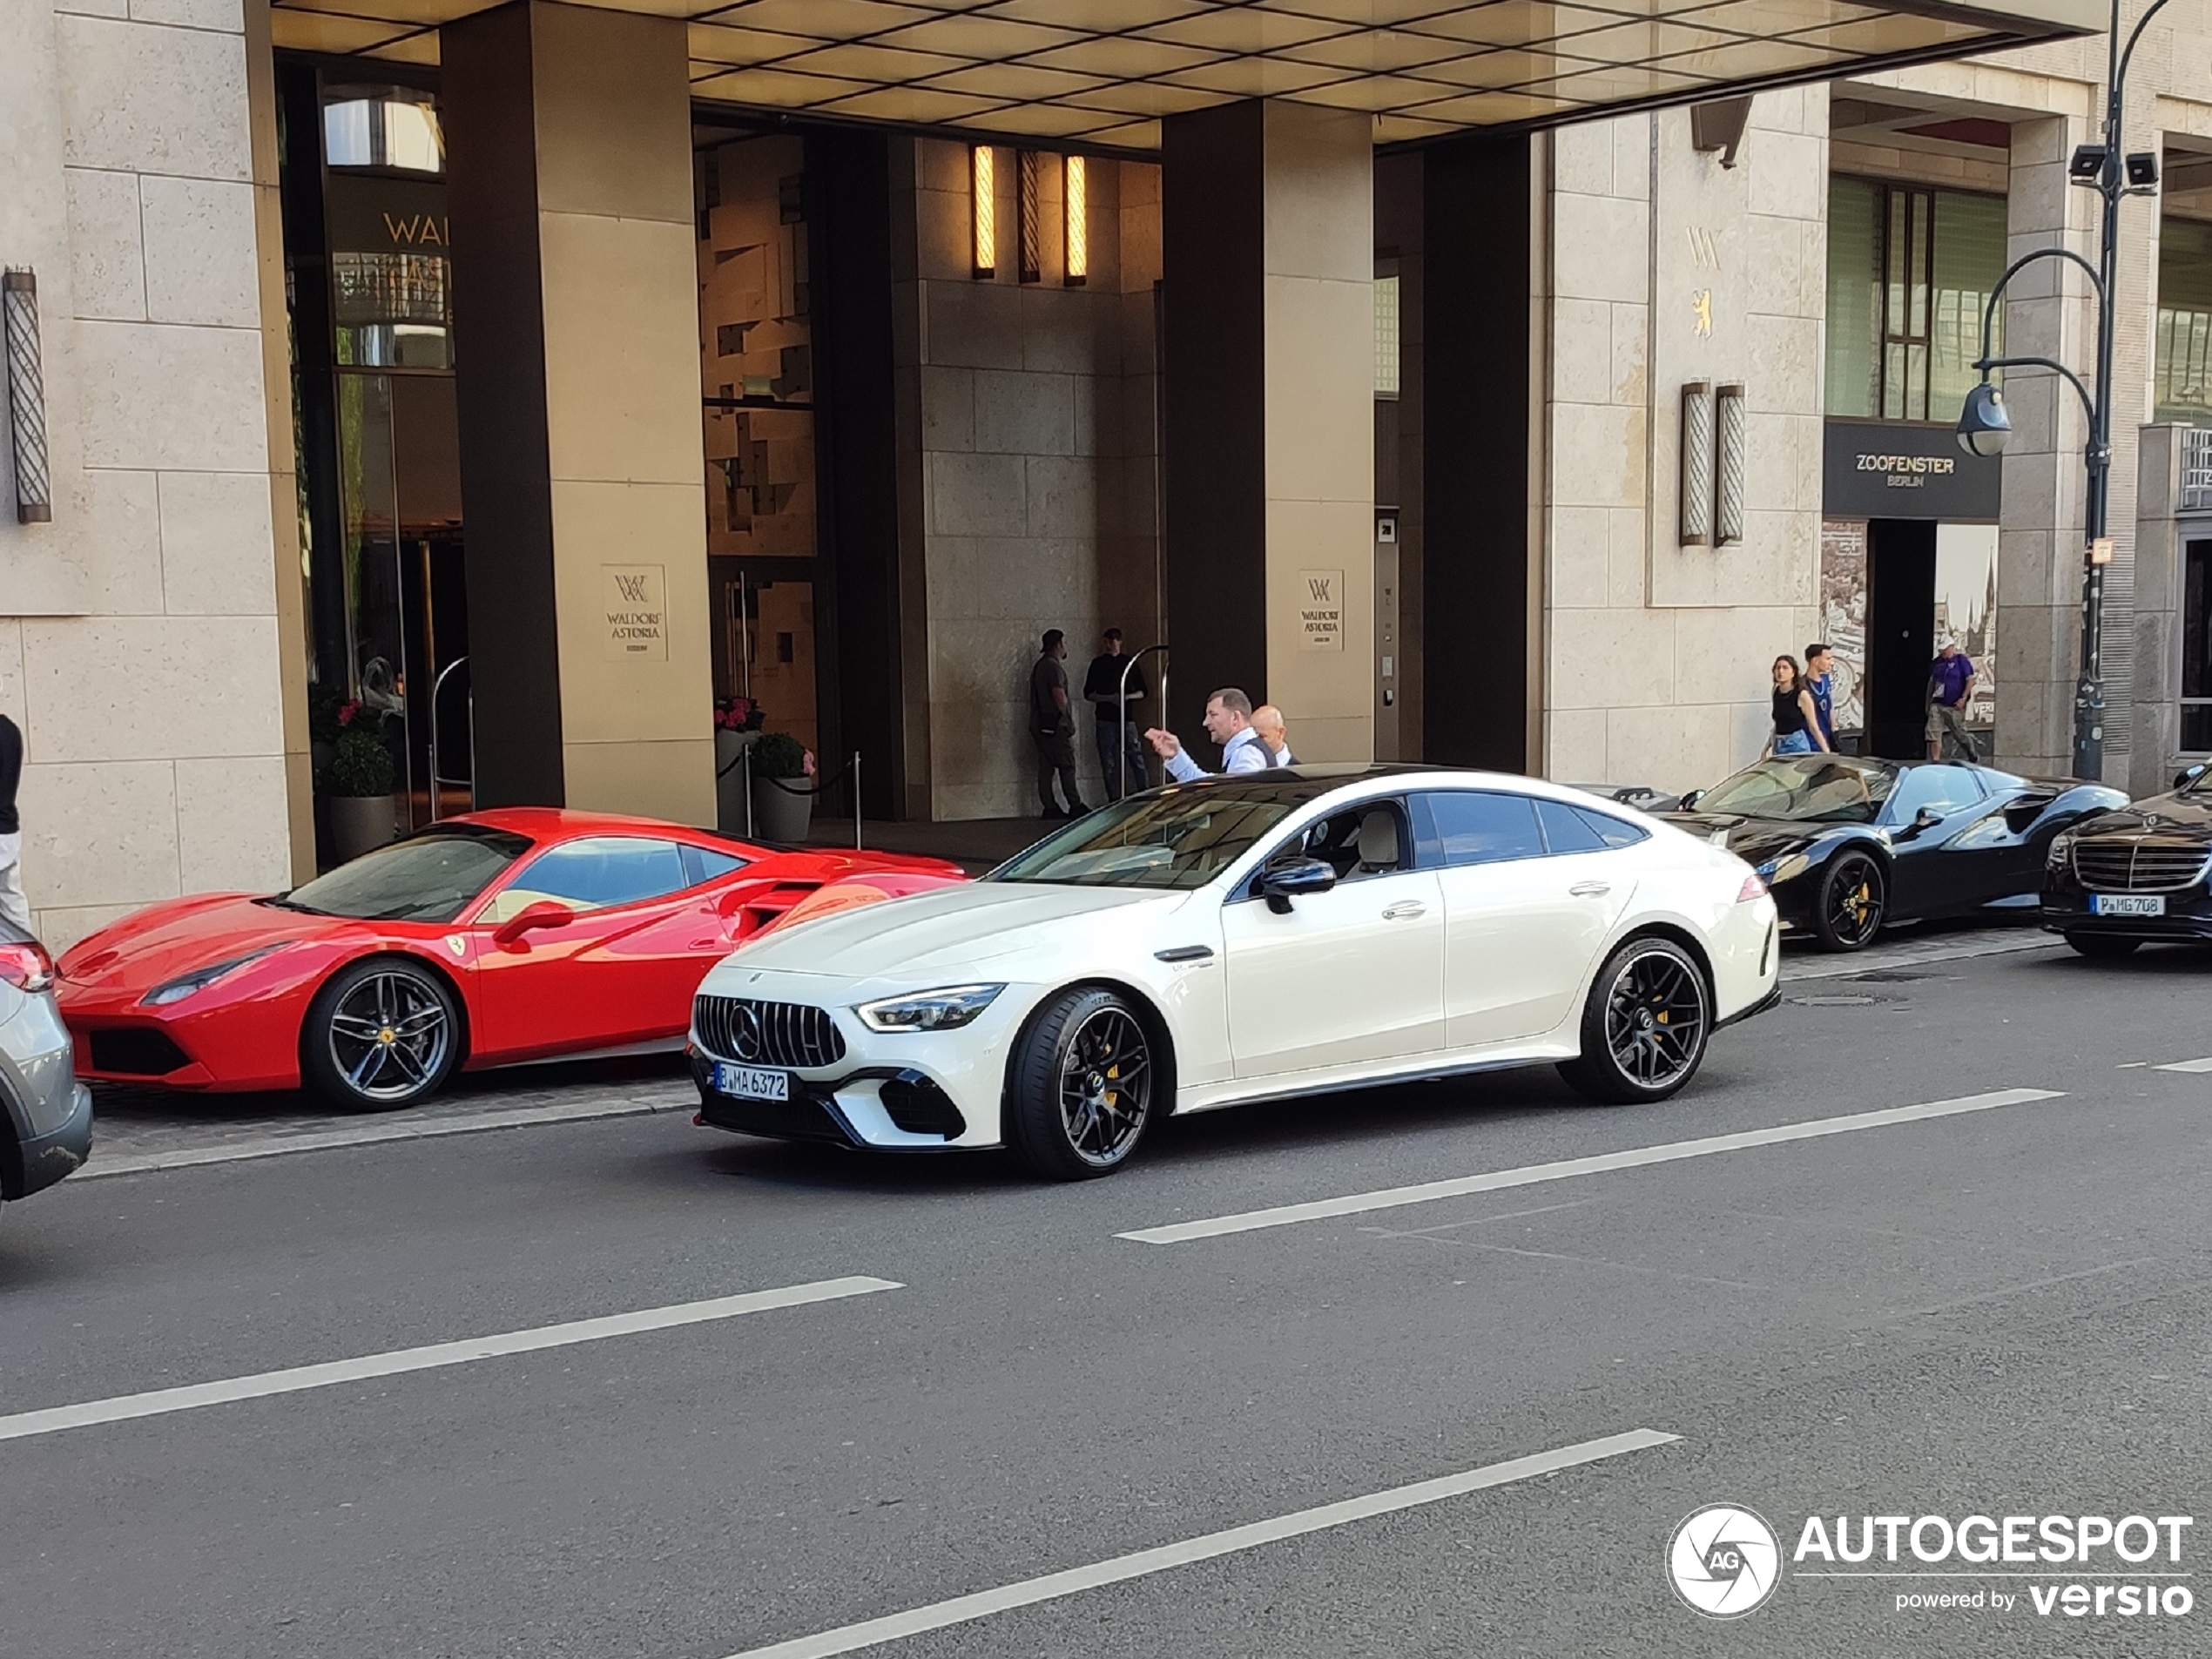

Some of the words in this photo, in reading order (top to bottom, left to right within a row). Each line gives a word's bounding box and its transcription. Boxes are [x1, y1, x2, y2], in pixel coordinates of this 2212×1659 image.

[1856, 455, 1954, 474] ZOOFENSTER
[1887, 475, 1924, 487] BERLIN
[607, 612, 662, 624] WALDORF
[1301, 610, 1339, 620] WALDORF
[612, 627, 660, 638] ASTORIA
[1305, 622, 1338, 632] ASTORIA
[2134, 898, 2158, 912] 708
[720, 1067, 727, 1089] B
[733, 1069, 749, 1092] MA
[752, 1072, 786, 1096] 6372
